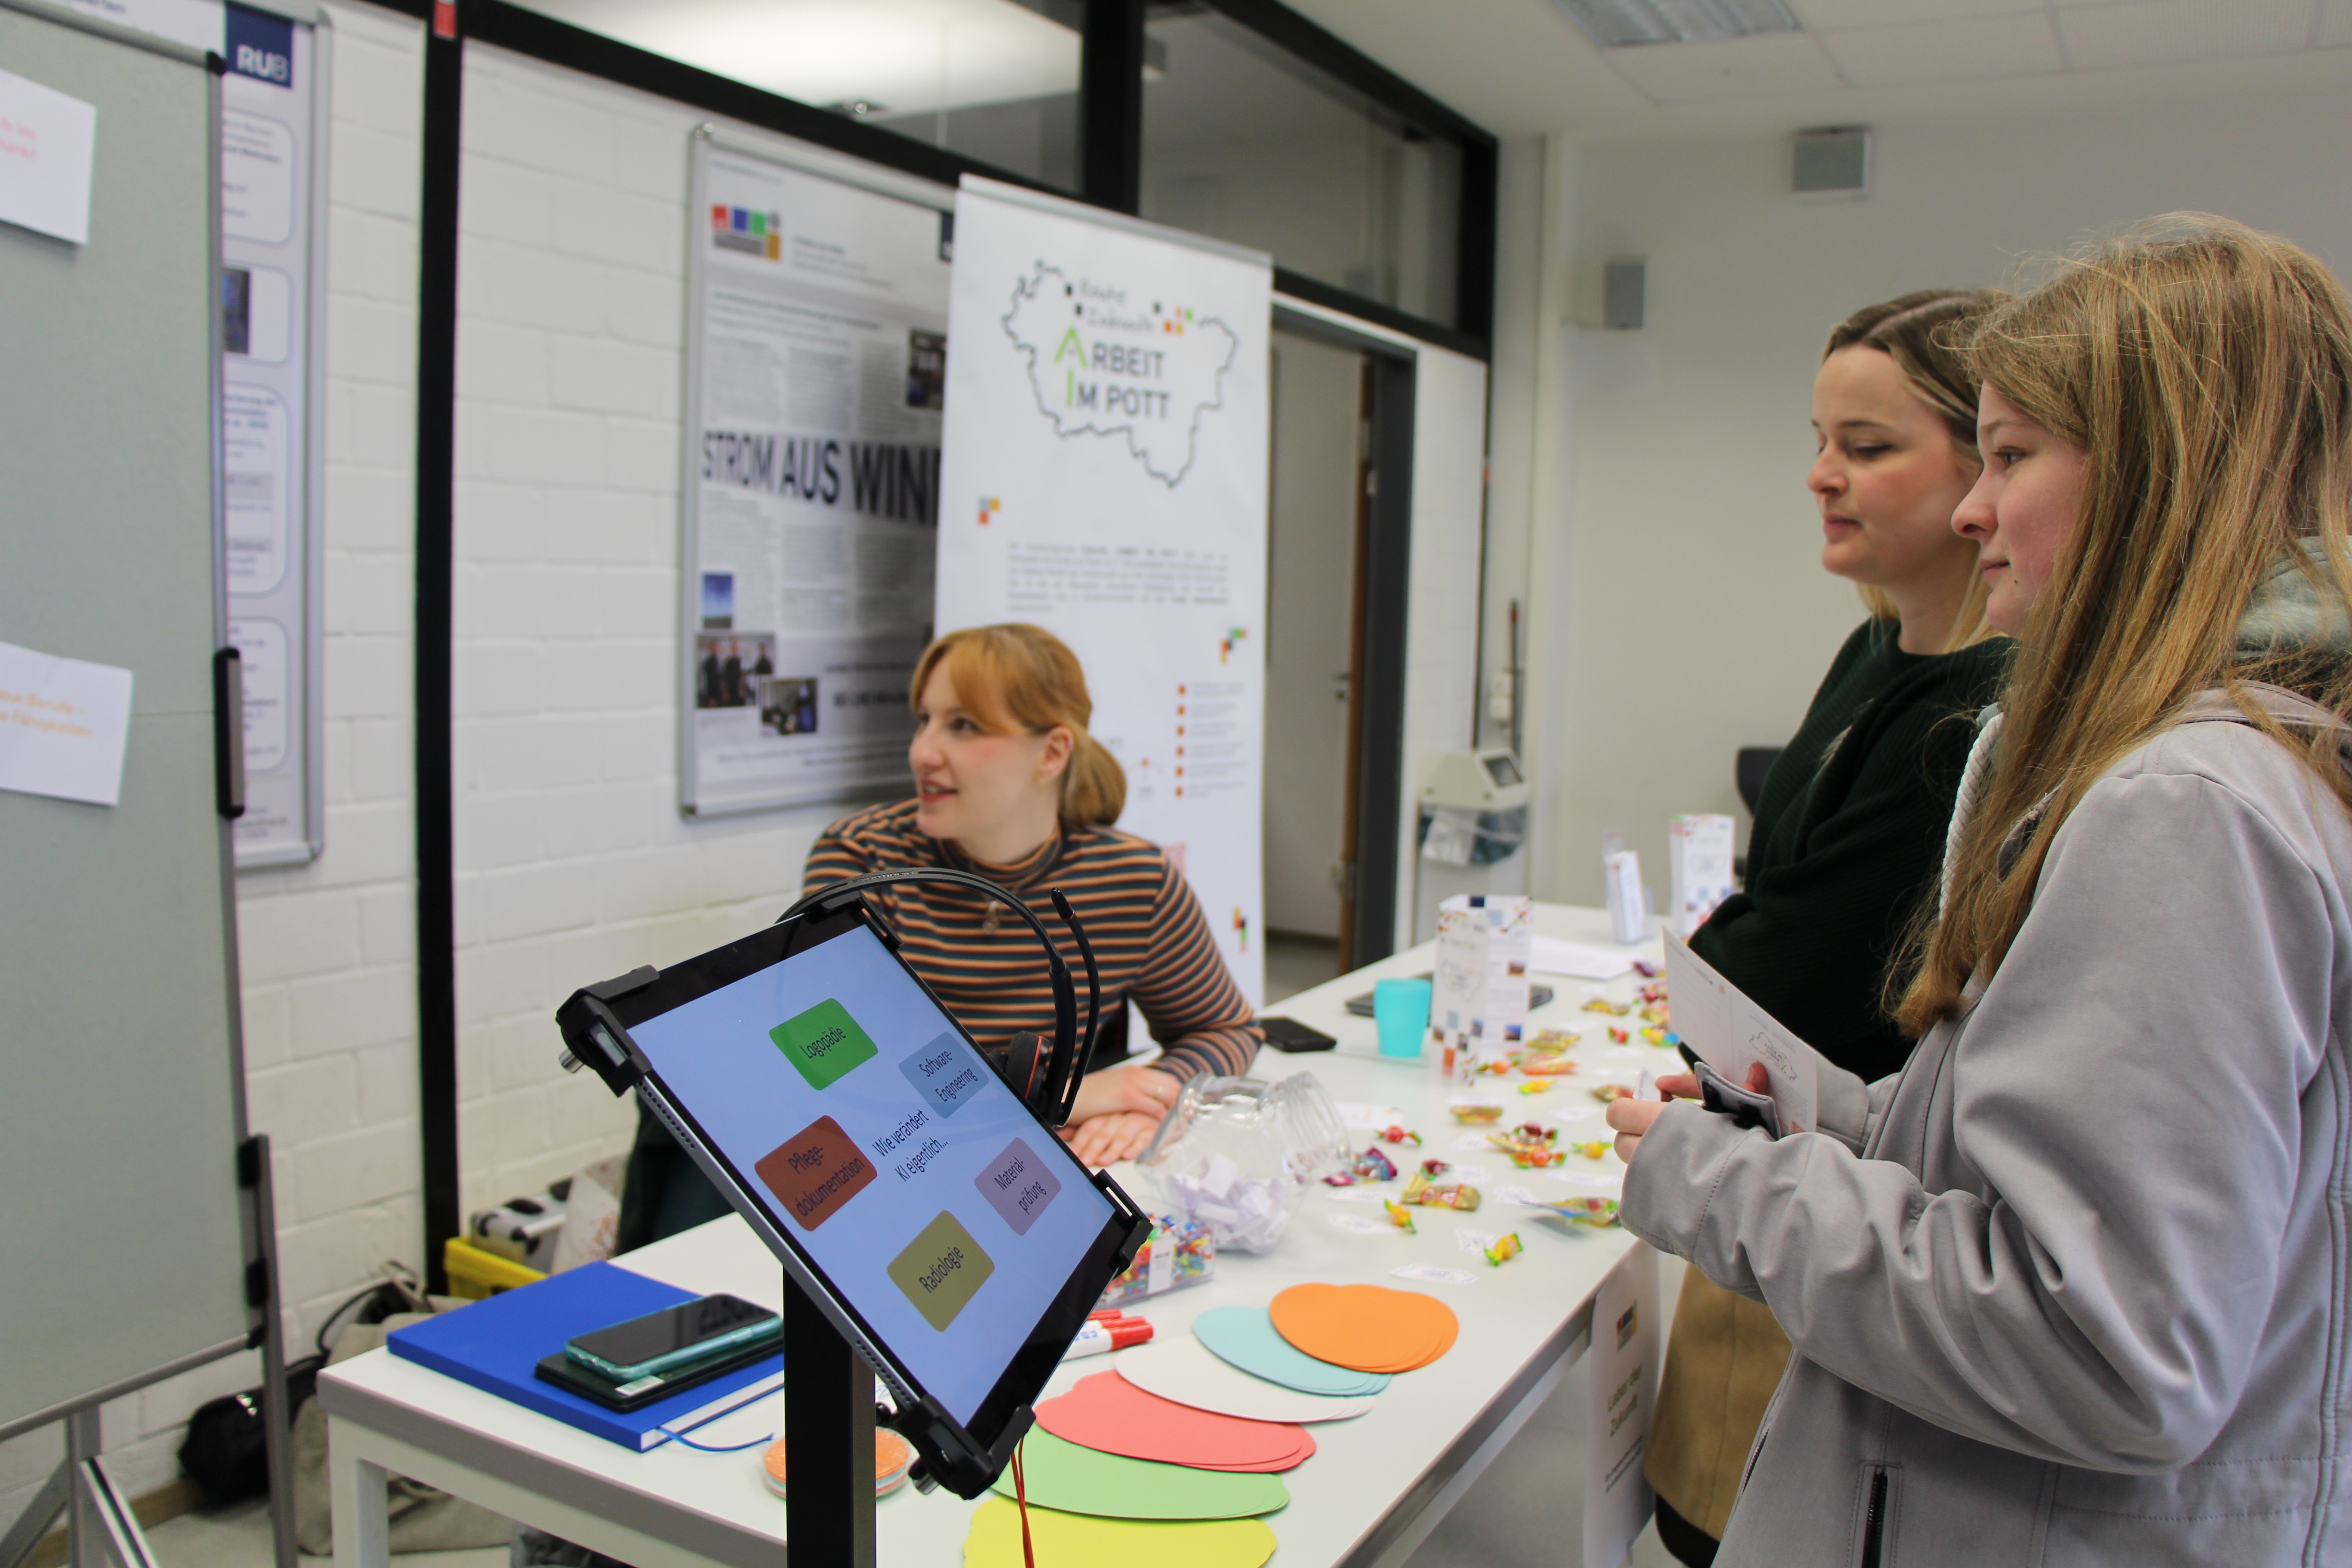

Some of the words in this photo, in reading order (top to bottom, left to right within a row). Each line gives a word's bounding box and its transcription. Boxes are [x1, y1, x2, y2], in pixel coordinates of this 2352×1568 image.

[237, 44, 289, 81] RUB
[1054, 326, 1165, 380] ARBEIT
[1066, 368, 1098, 410] IM
[1106, 384, 1170, 421] POTT
[702, 430, 774, 492] STROM
[779, 438, 841, 505] AUS
[852, 870, 914, 883] plantronics
[799, 1027, 847, 1059] Logopädie
[919, 1049, 953, 1078] Software-
[935, 1068, 979, 1102] Engineering
[872, 1137, 896, 1157] Wie
[890, 1109, 929, 1143] verändert
[787, 1145, 824, 1175] Pflege-
[894, 1163, 910, 1182] KI
[995, 1156, 1024, 1191] Material-
[795, 1156, 866, 1217] dokumentation
[1018, 1181, 1047, 1215] prüfung
[919, 1246, 964, 1294] Radiologie
